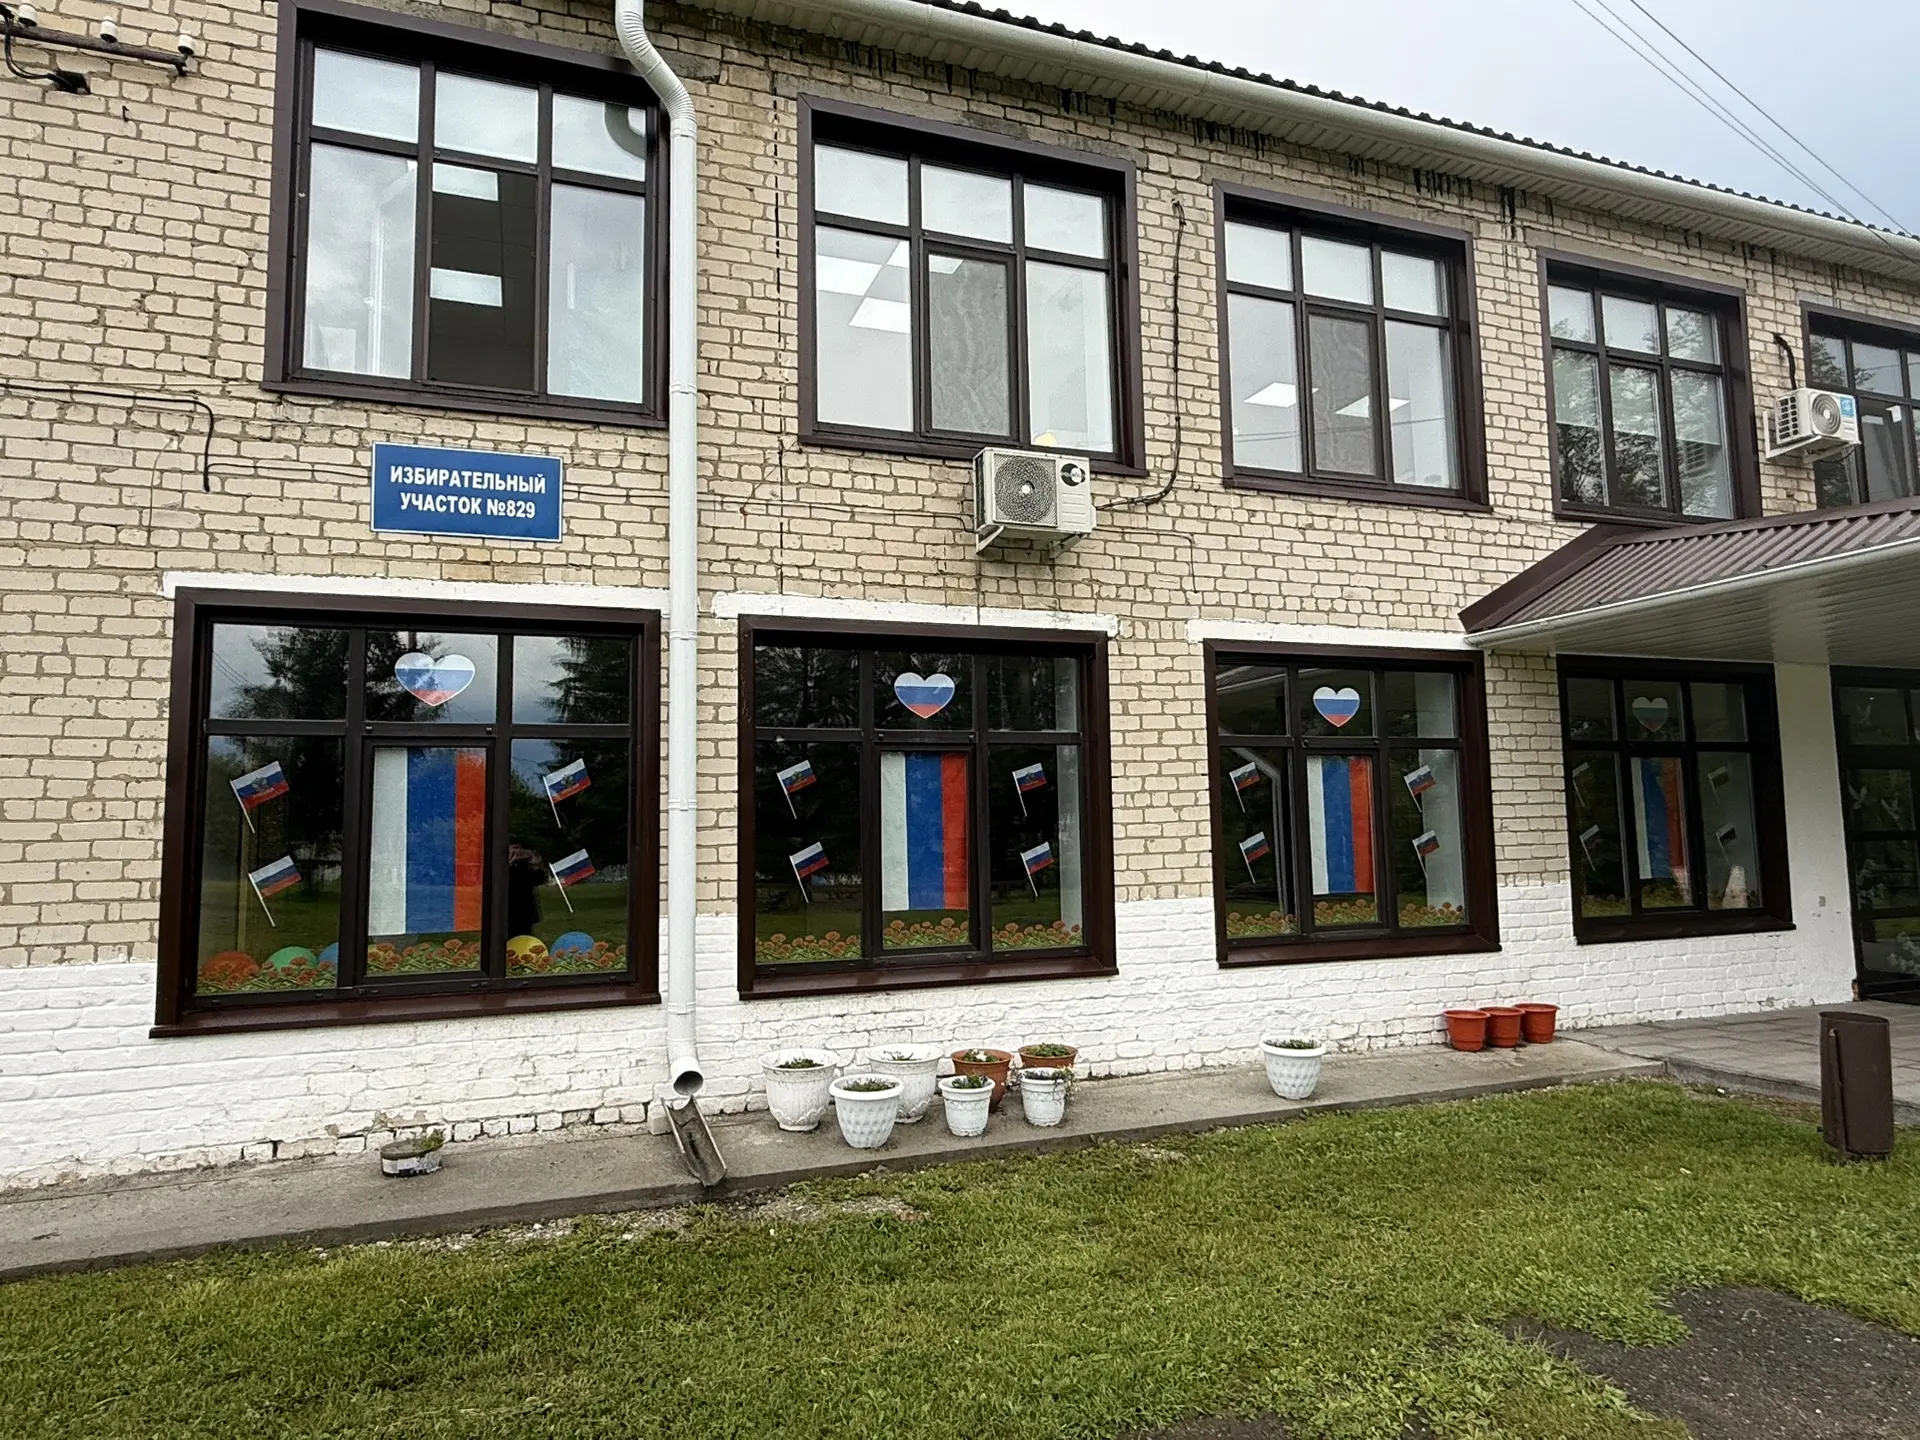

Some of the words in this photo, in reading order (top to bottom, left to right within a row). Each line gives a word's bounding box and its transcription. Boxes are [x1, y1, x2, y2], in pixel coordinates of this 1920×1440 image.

[390, 465, 546, 494] ИЗБИРАТЕЛЬНЫЙ
[400, 492, 482, 515] УЧАСТОК
[486, 499, 536, 518] №829
